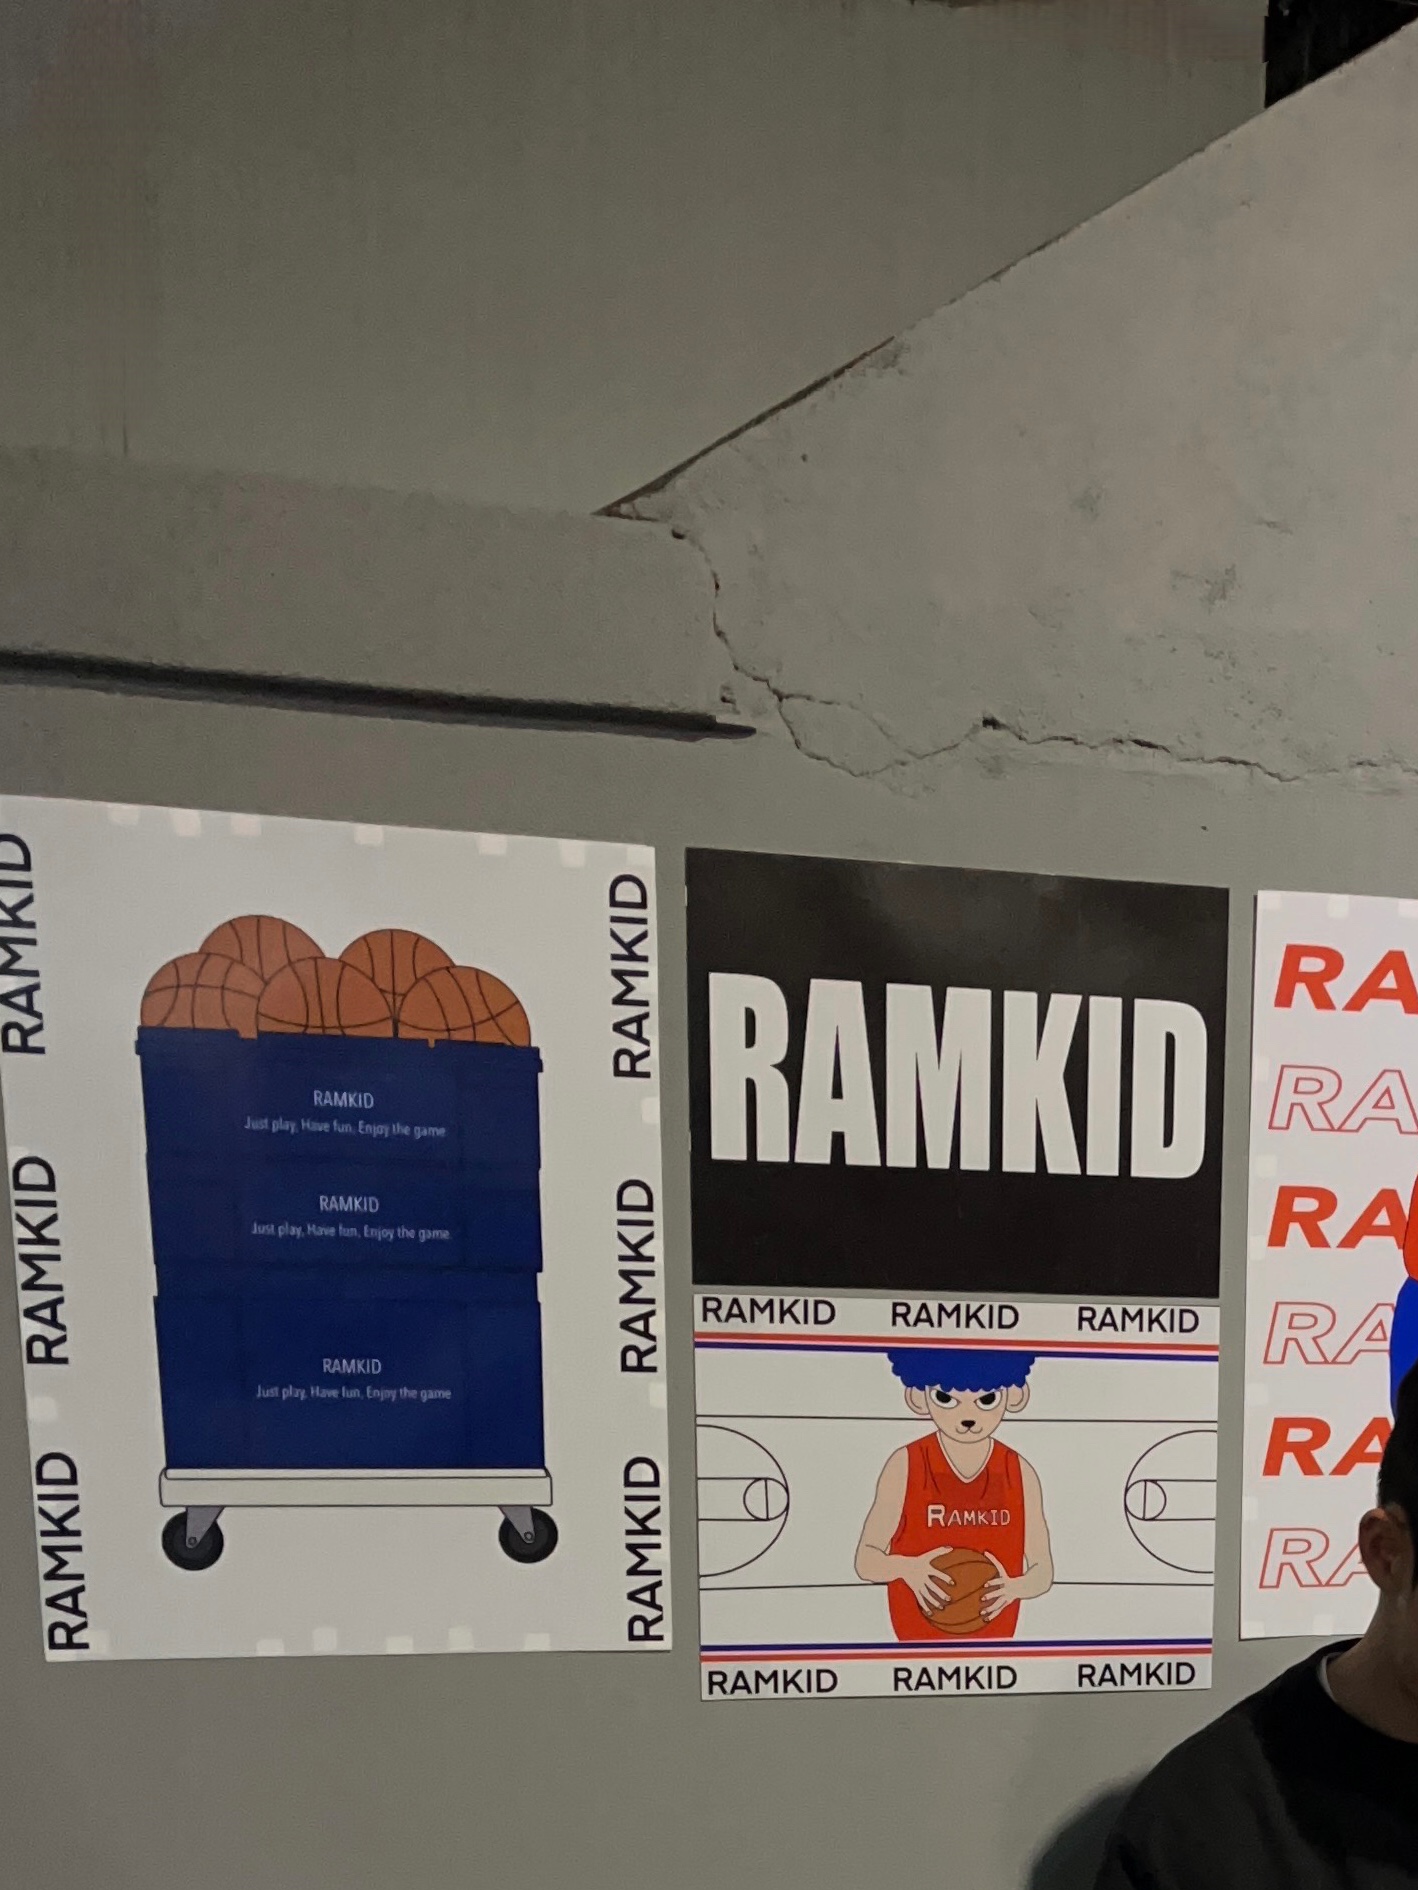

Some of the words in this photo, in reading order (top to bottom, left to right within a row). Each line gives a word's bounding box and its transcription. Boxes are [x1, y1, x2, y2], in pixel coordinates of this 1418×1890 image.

[0, 833, 46, 1055] RAMKID
[609, 873, 652, 1079] RAMKID
[708, 972, 1208, 1179] RAMKID
[313, 1089, 375, 1109] RAMKID
[244, 1116, 269, 1130] Just
[301, 1119, 330, 1132] Have
[358, 1120, 390, 1138] Enjoy
[392, 1121, 410, 1135] the
[414, 1126, 446, 1139] game
[319, 1195, 380, 1213] RAMKID
[251, 1221, 275, 1235] Just
[307, 1223, 336, 1237] Have
[363, 1225, 394, 1242] Enjoy
[397, 1226, 415, 1239] the
[419, 1229, 450, 1243] game
[13, 1155, 70, 1365] RAMKID
[617, 1179, 658, 1373] RAMKID
[702, 1297, 836, 1326] RAMKID
[891, 1301, 1019, 1330] RAMKID
[1077, 1306, 1199, 1334] RAMKID
[322, 1358, 382, 1375] RAMKID
[256, 1384, 279, 1398] Just
[310, 1386, 339, 1399] Have
[366, 1386, 396, 1402] Enjoy
[400, 1387, 417, 1399] the
[420, 1389, 451, 1403] game
[36, 1451, 90, 1650] RAMKID
[624, 1456, 664, 1642] RAMKID
[707, 1669, 838, 1696] RAMKID
[893, 1665, 1018, 1692] RAMKID
[1078, 1661, 1196, 1689] RAMKID
